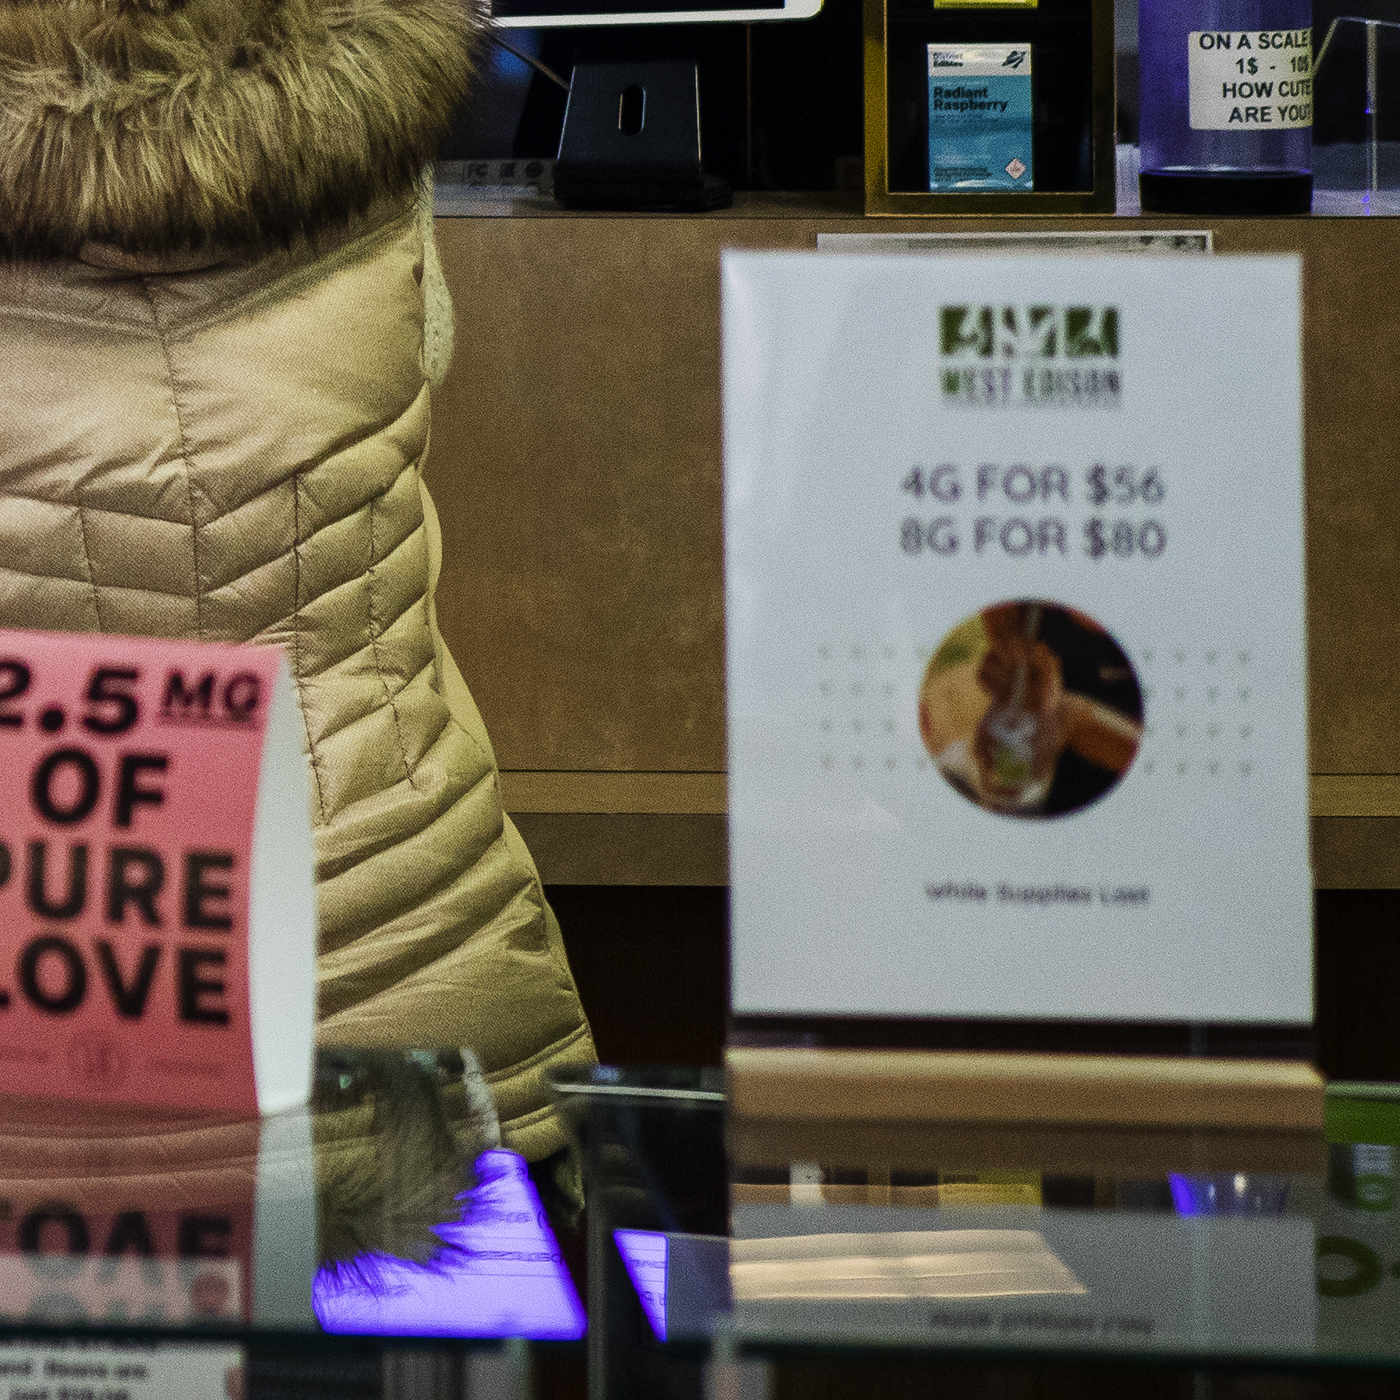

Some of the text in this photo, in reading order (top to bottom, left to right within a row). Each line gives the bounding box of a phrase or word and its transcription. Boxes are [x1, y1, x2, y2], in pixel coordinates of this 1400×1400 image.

[1199, 32, 1231, 50] ON
[1236, 34, 1252, 50] A
[1235, 56, 1259, 75] 1$
[933, 86, 988, 99] Radiant
[1222, 78, 1312, 98] HOW CUTE
[933, 100, 1009, 112] Raspberry
[1228, 106, 1272, 123] ARE
[900, 462, 1167, 506] 4G FOR $56
[899, 516, 1168, 561] 8G FOR $80
[29, 744, 170, 830] OF
